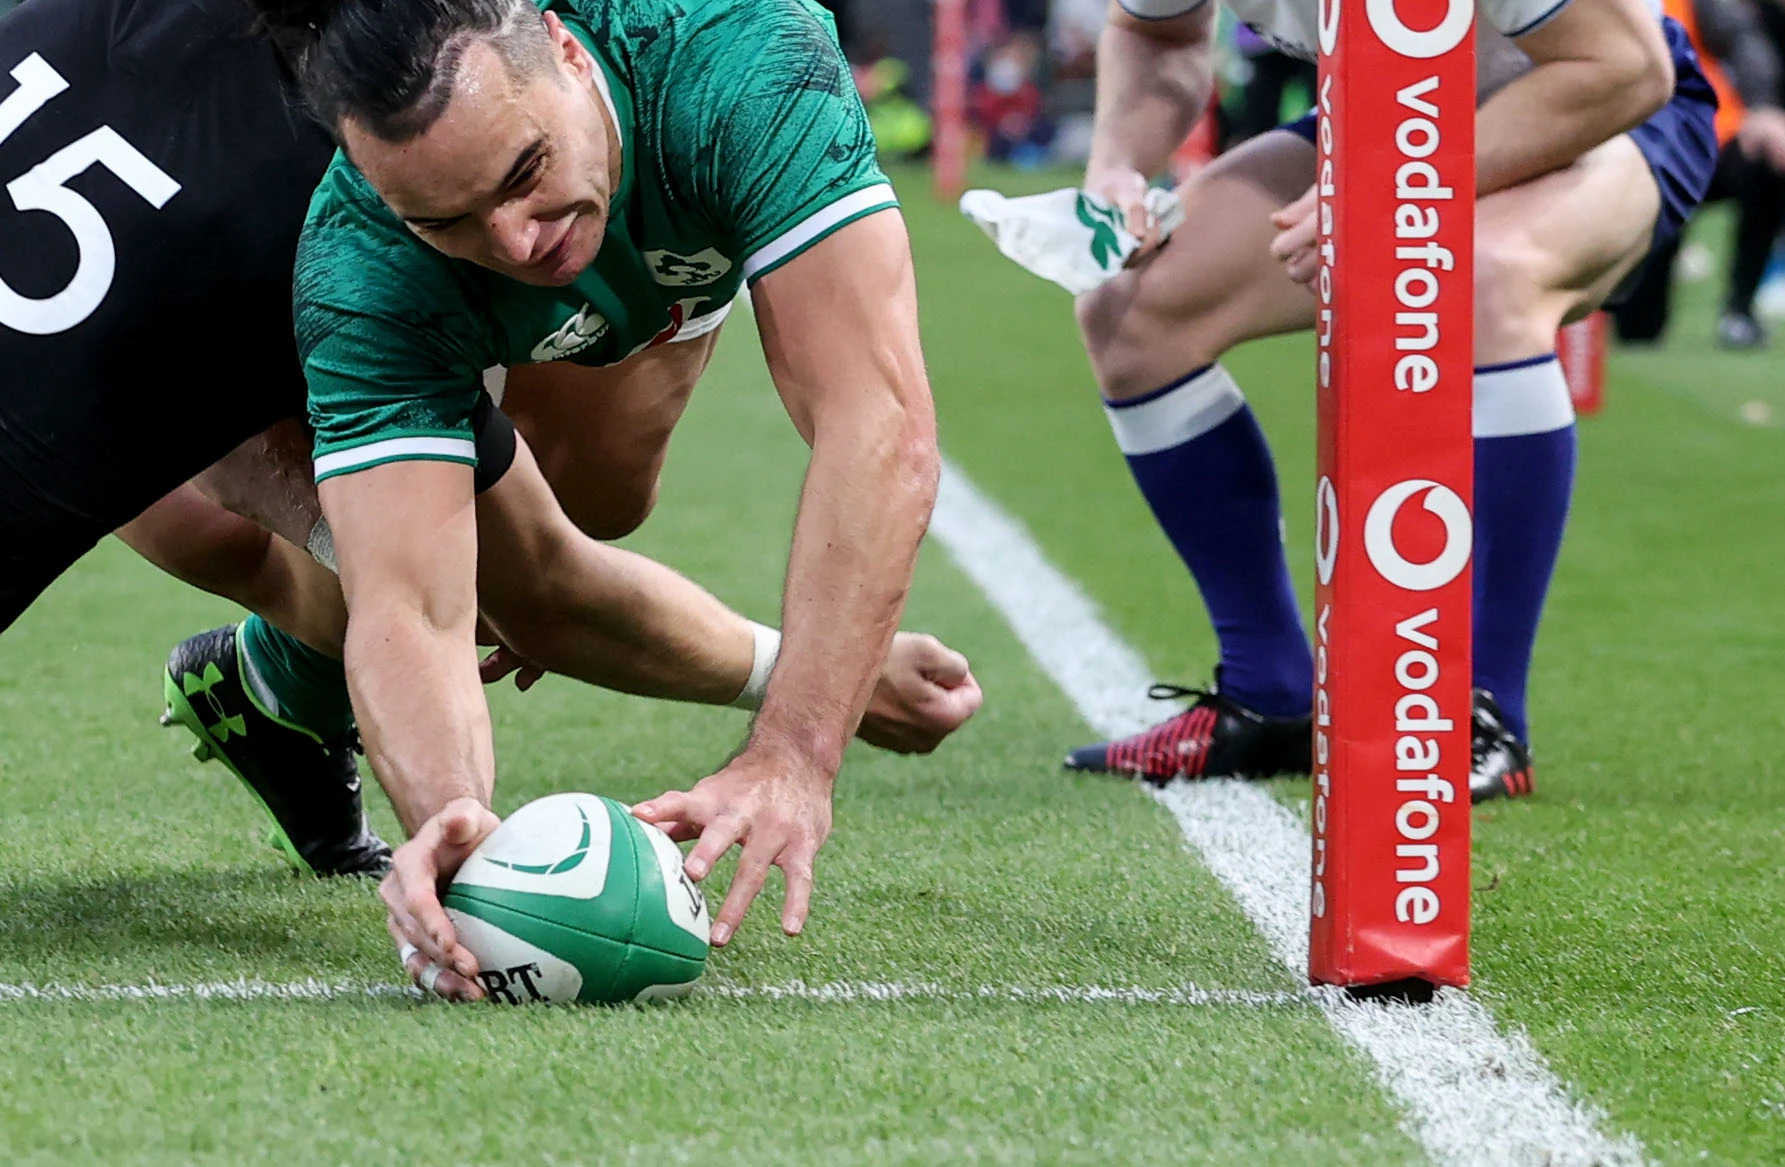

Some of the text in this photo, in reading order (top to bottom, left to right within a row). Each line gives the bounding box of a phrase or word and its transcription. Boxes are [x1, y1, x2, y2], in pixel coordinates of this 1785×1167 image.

[1394, 75, 1455, 393] vodafone
[1394, 608, 1455, 925] vodafone
[477, 962, 544, 1007] RT
